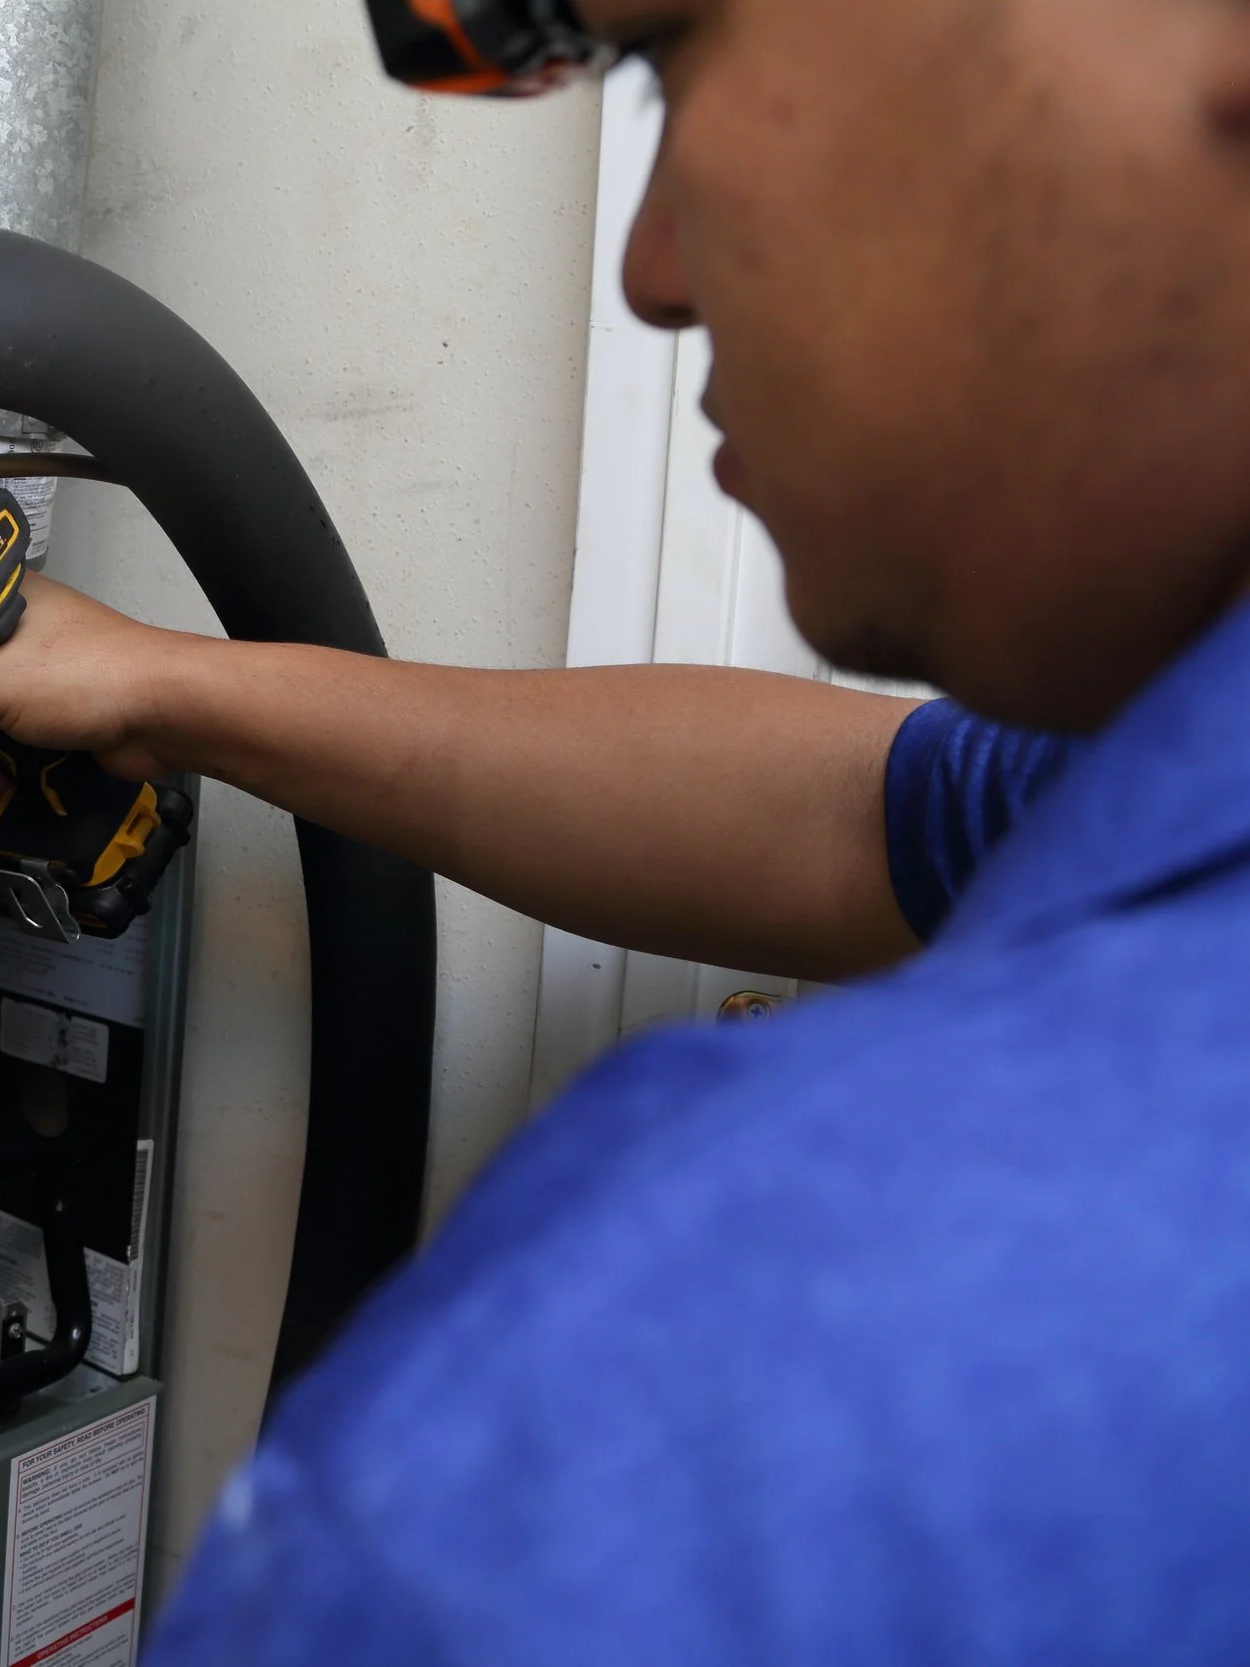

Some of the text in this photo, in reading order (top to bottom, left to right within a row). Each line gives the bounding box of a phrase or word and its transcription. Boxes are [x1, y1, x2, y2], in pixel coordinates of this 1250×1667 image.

[22, 1459, 34, 1468] FOR
[36, 1451, 51, 1462] YOUR
[76, 1433, 91, 1444] READ
[93, 1422, 113, 1436] BEFORE
[116, 1408, 145, 1426] OPERATING
